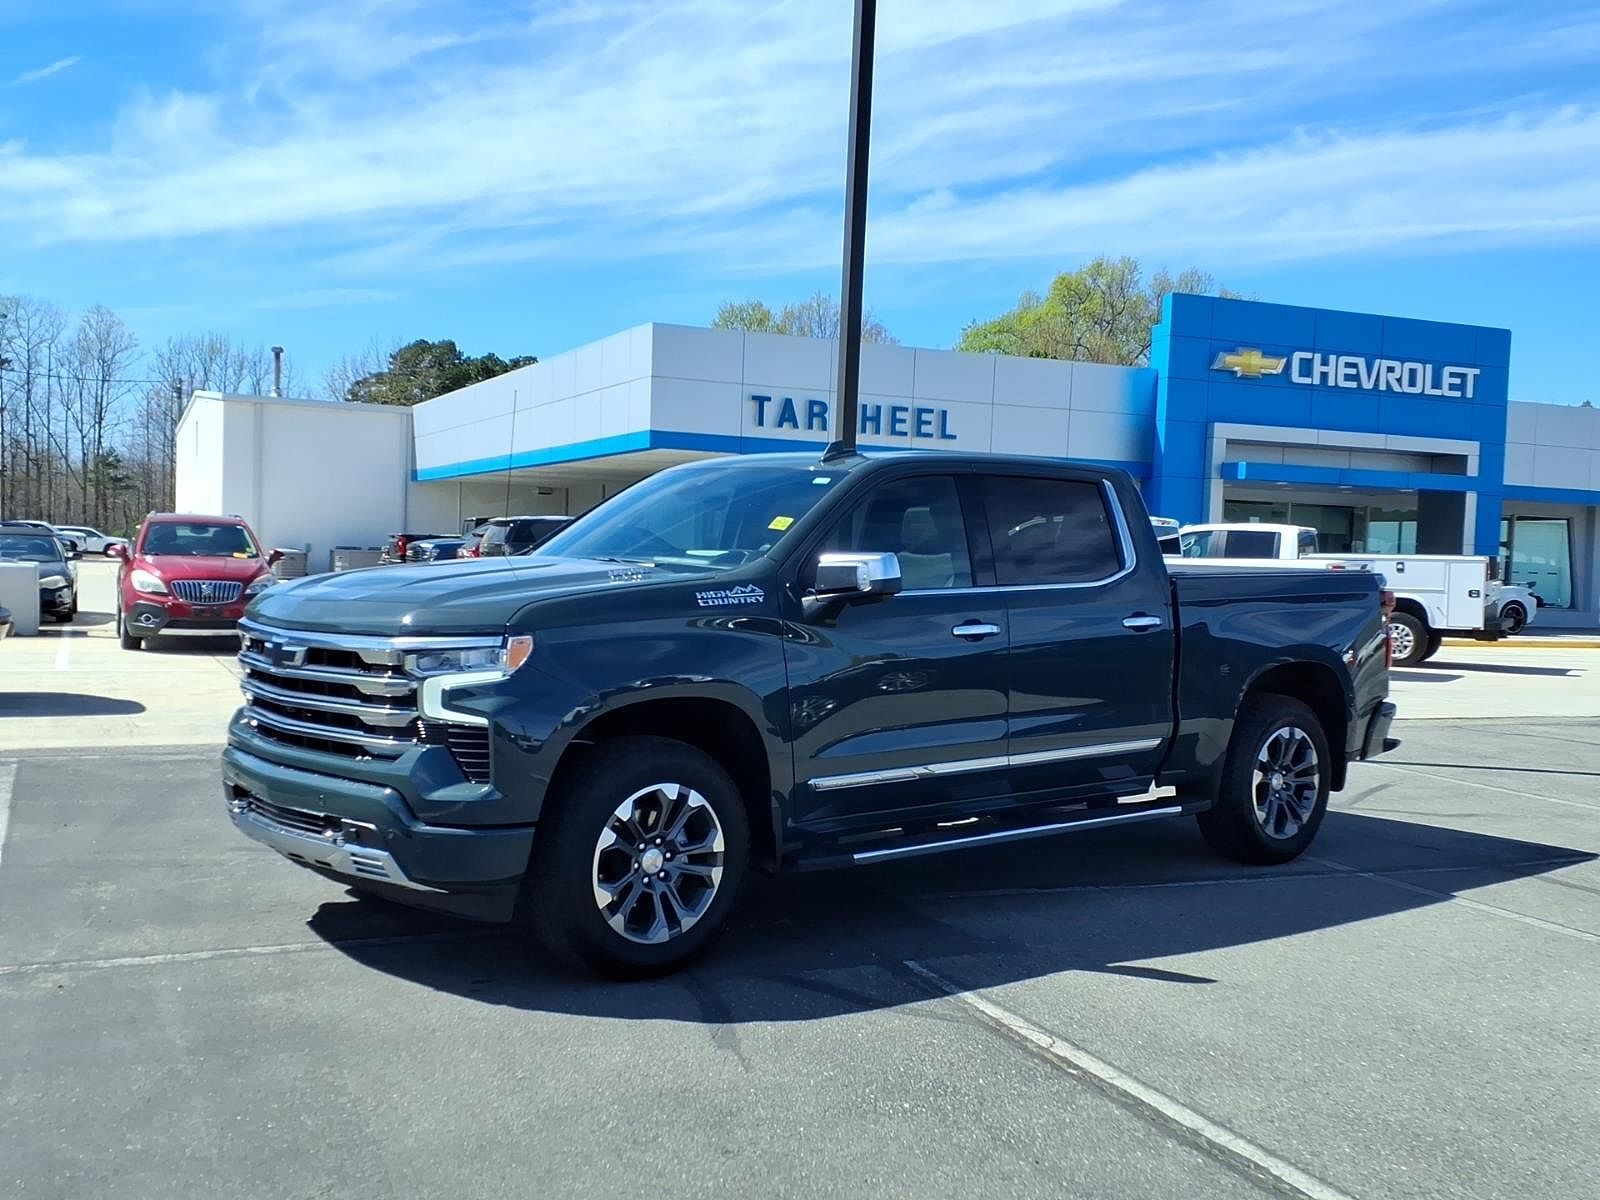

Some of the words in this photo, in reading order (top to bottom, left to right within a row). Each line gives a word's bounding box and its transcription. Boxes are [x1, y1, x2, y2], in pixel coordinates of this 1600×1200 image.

[1291, 351, 1480, 398] CHEVROLET
[751, 395, 829, 431] TAR
[860, 403, 957, 440] HEEL
[696, 589, 732, 599] HIGH
[698, 596, 765, 606] COUNTRY
